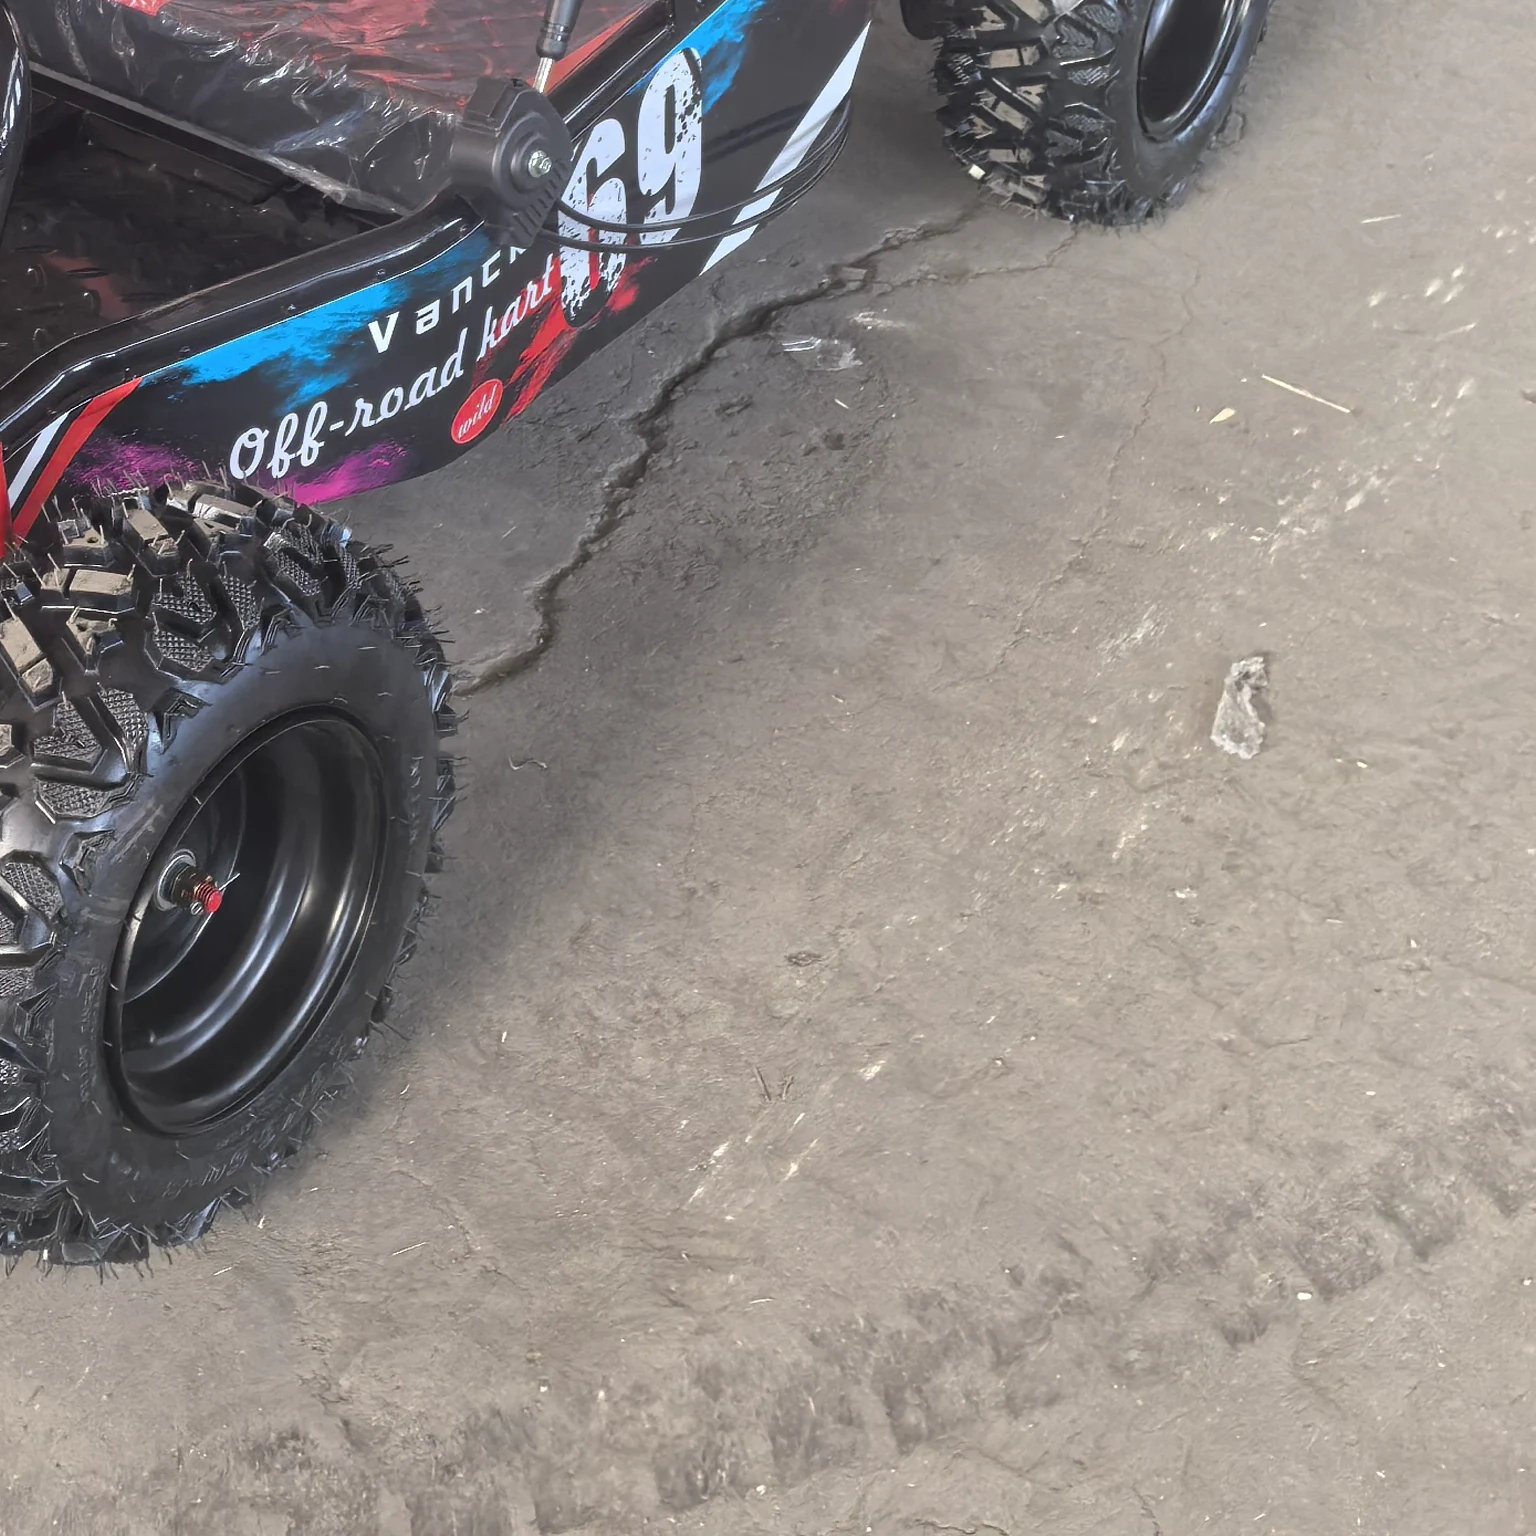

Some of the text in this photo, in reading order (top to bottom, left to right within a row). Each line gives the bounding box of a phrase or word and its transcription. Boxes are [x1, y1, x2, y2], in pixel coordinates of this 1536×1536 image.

[557, 47, 703, 321] 69
[231, 253, 554, 481] Off-road kart
